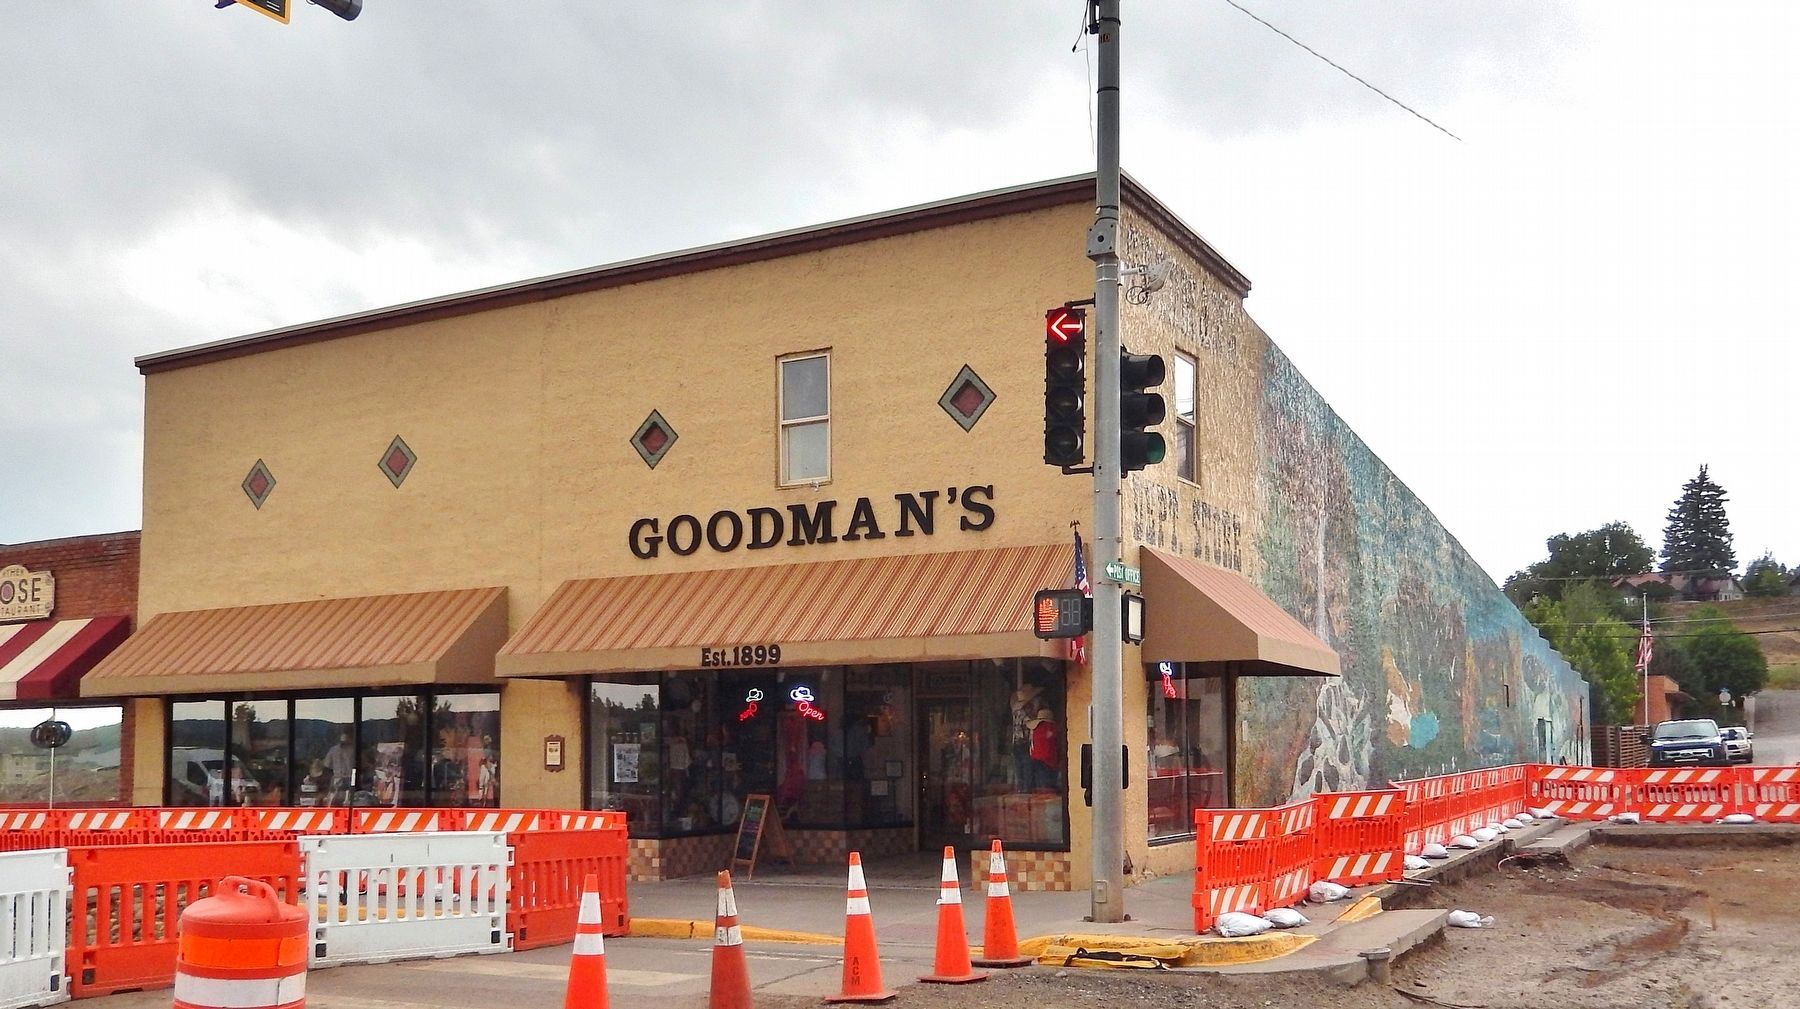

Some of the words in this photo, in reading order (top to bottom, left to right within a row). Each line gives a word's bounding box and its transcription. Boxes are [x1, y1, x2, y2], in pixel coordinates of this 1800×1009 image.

[628, 484, 996, 560] GOODMAN'S
[1113, 564, 1124, 579] POST
[1125, 567, 1140, 584] OFFICE
[798, 700, 824, 721] Open
